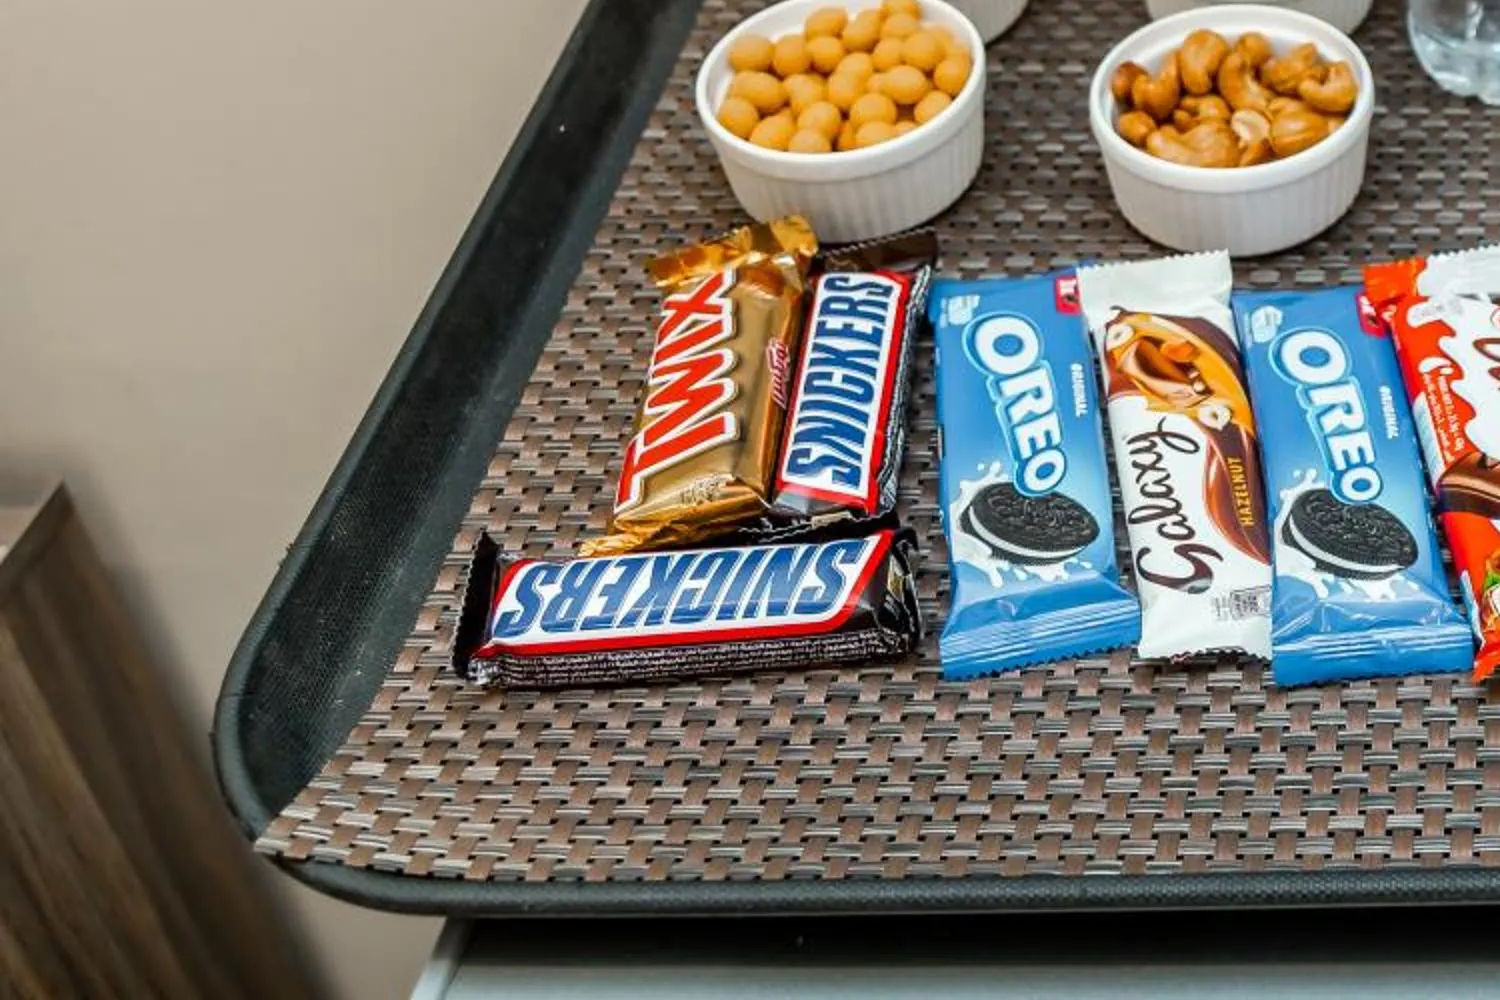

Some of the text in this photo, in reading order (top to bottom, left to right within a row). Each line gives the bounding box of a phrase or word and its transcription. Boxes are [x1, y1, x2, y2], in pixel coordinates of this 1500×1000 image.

[614, 266, 738, 514] TWIX
[785, 274, 894, 490] SNICKERS
[967, 313, 1067, 495] OREO
[1274, 329, 1382, 502] OREO
[1126, 416, 1224, 595] Galaxy
[1227, 456, 1255, 527] HAZELNUT
[492, 539, 867, 639] SNICKERS
